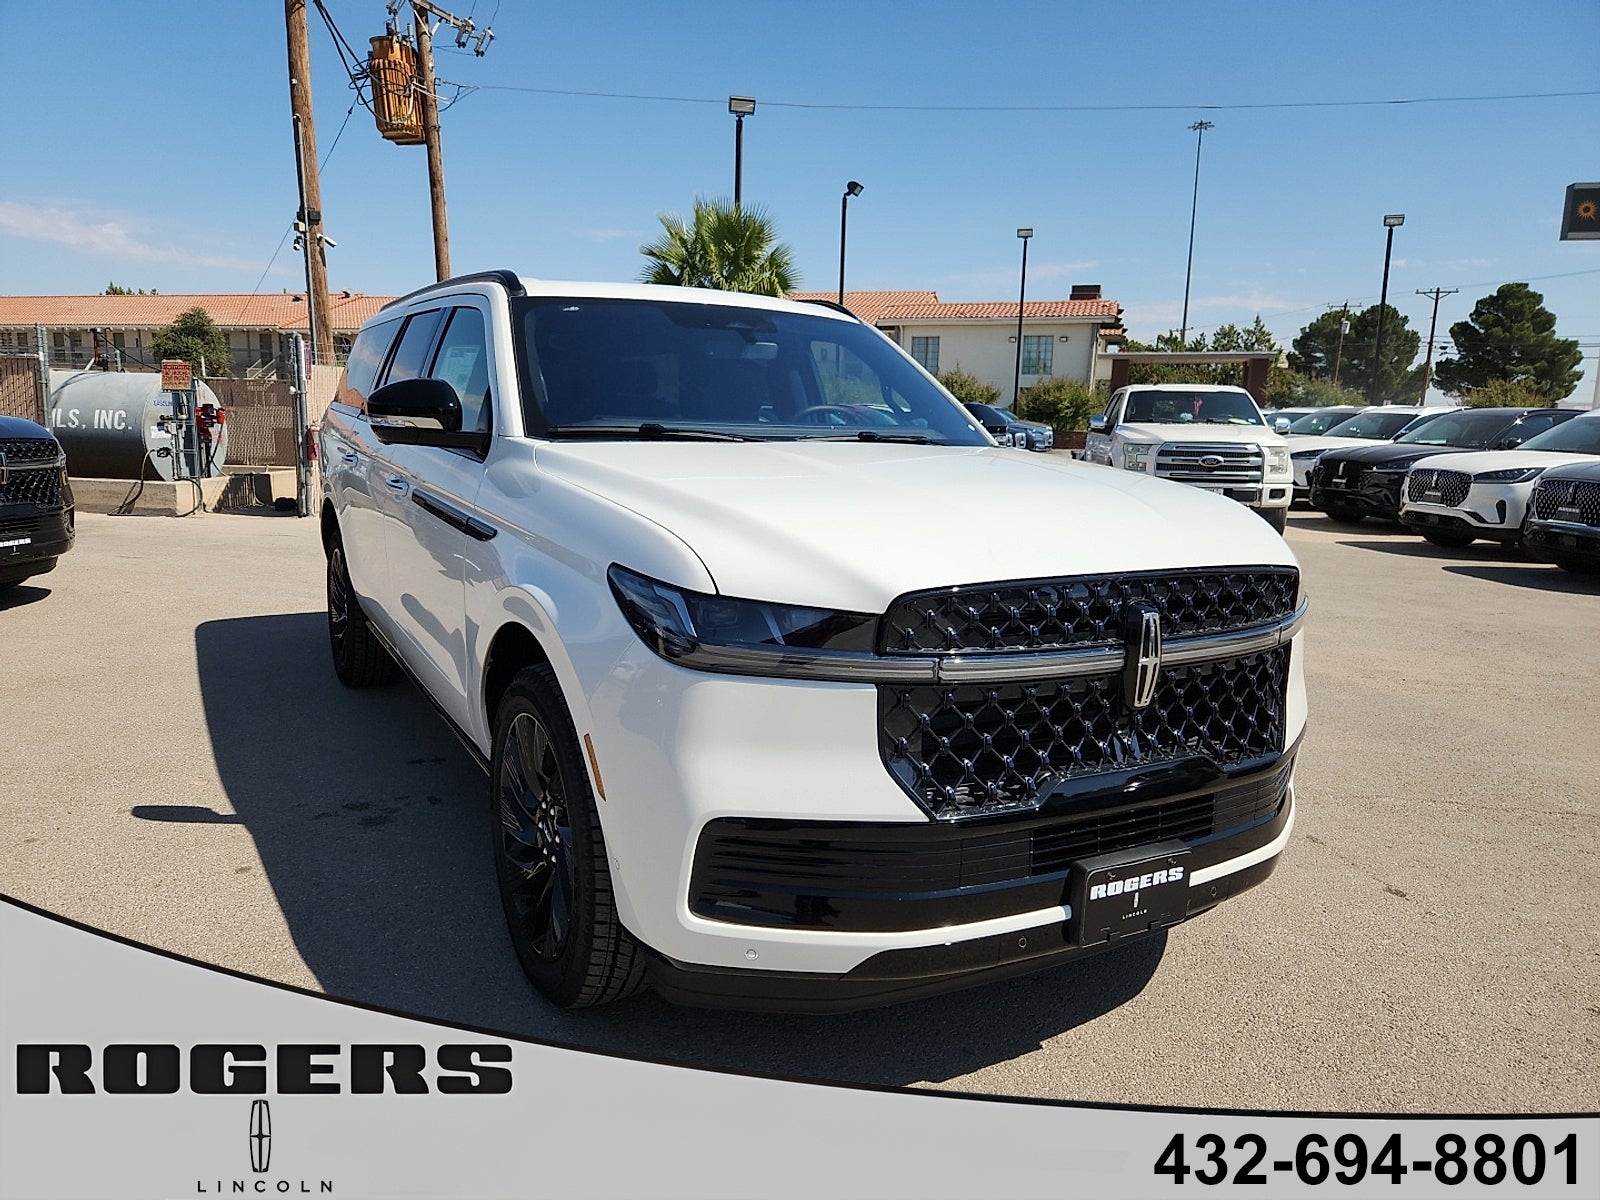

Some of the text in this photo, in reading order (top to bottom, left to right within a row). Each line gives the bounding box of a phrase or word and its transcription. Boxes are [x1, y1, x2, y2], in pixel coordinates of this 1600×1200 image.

[93, 409, 133, 431] INC.
[1089, 866, 1185, 901] ROGERS
[1122, 908, 1148, 920] LINCOLN
